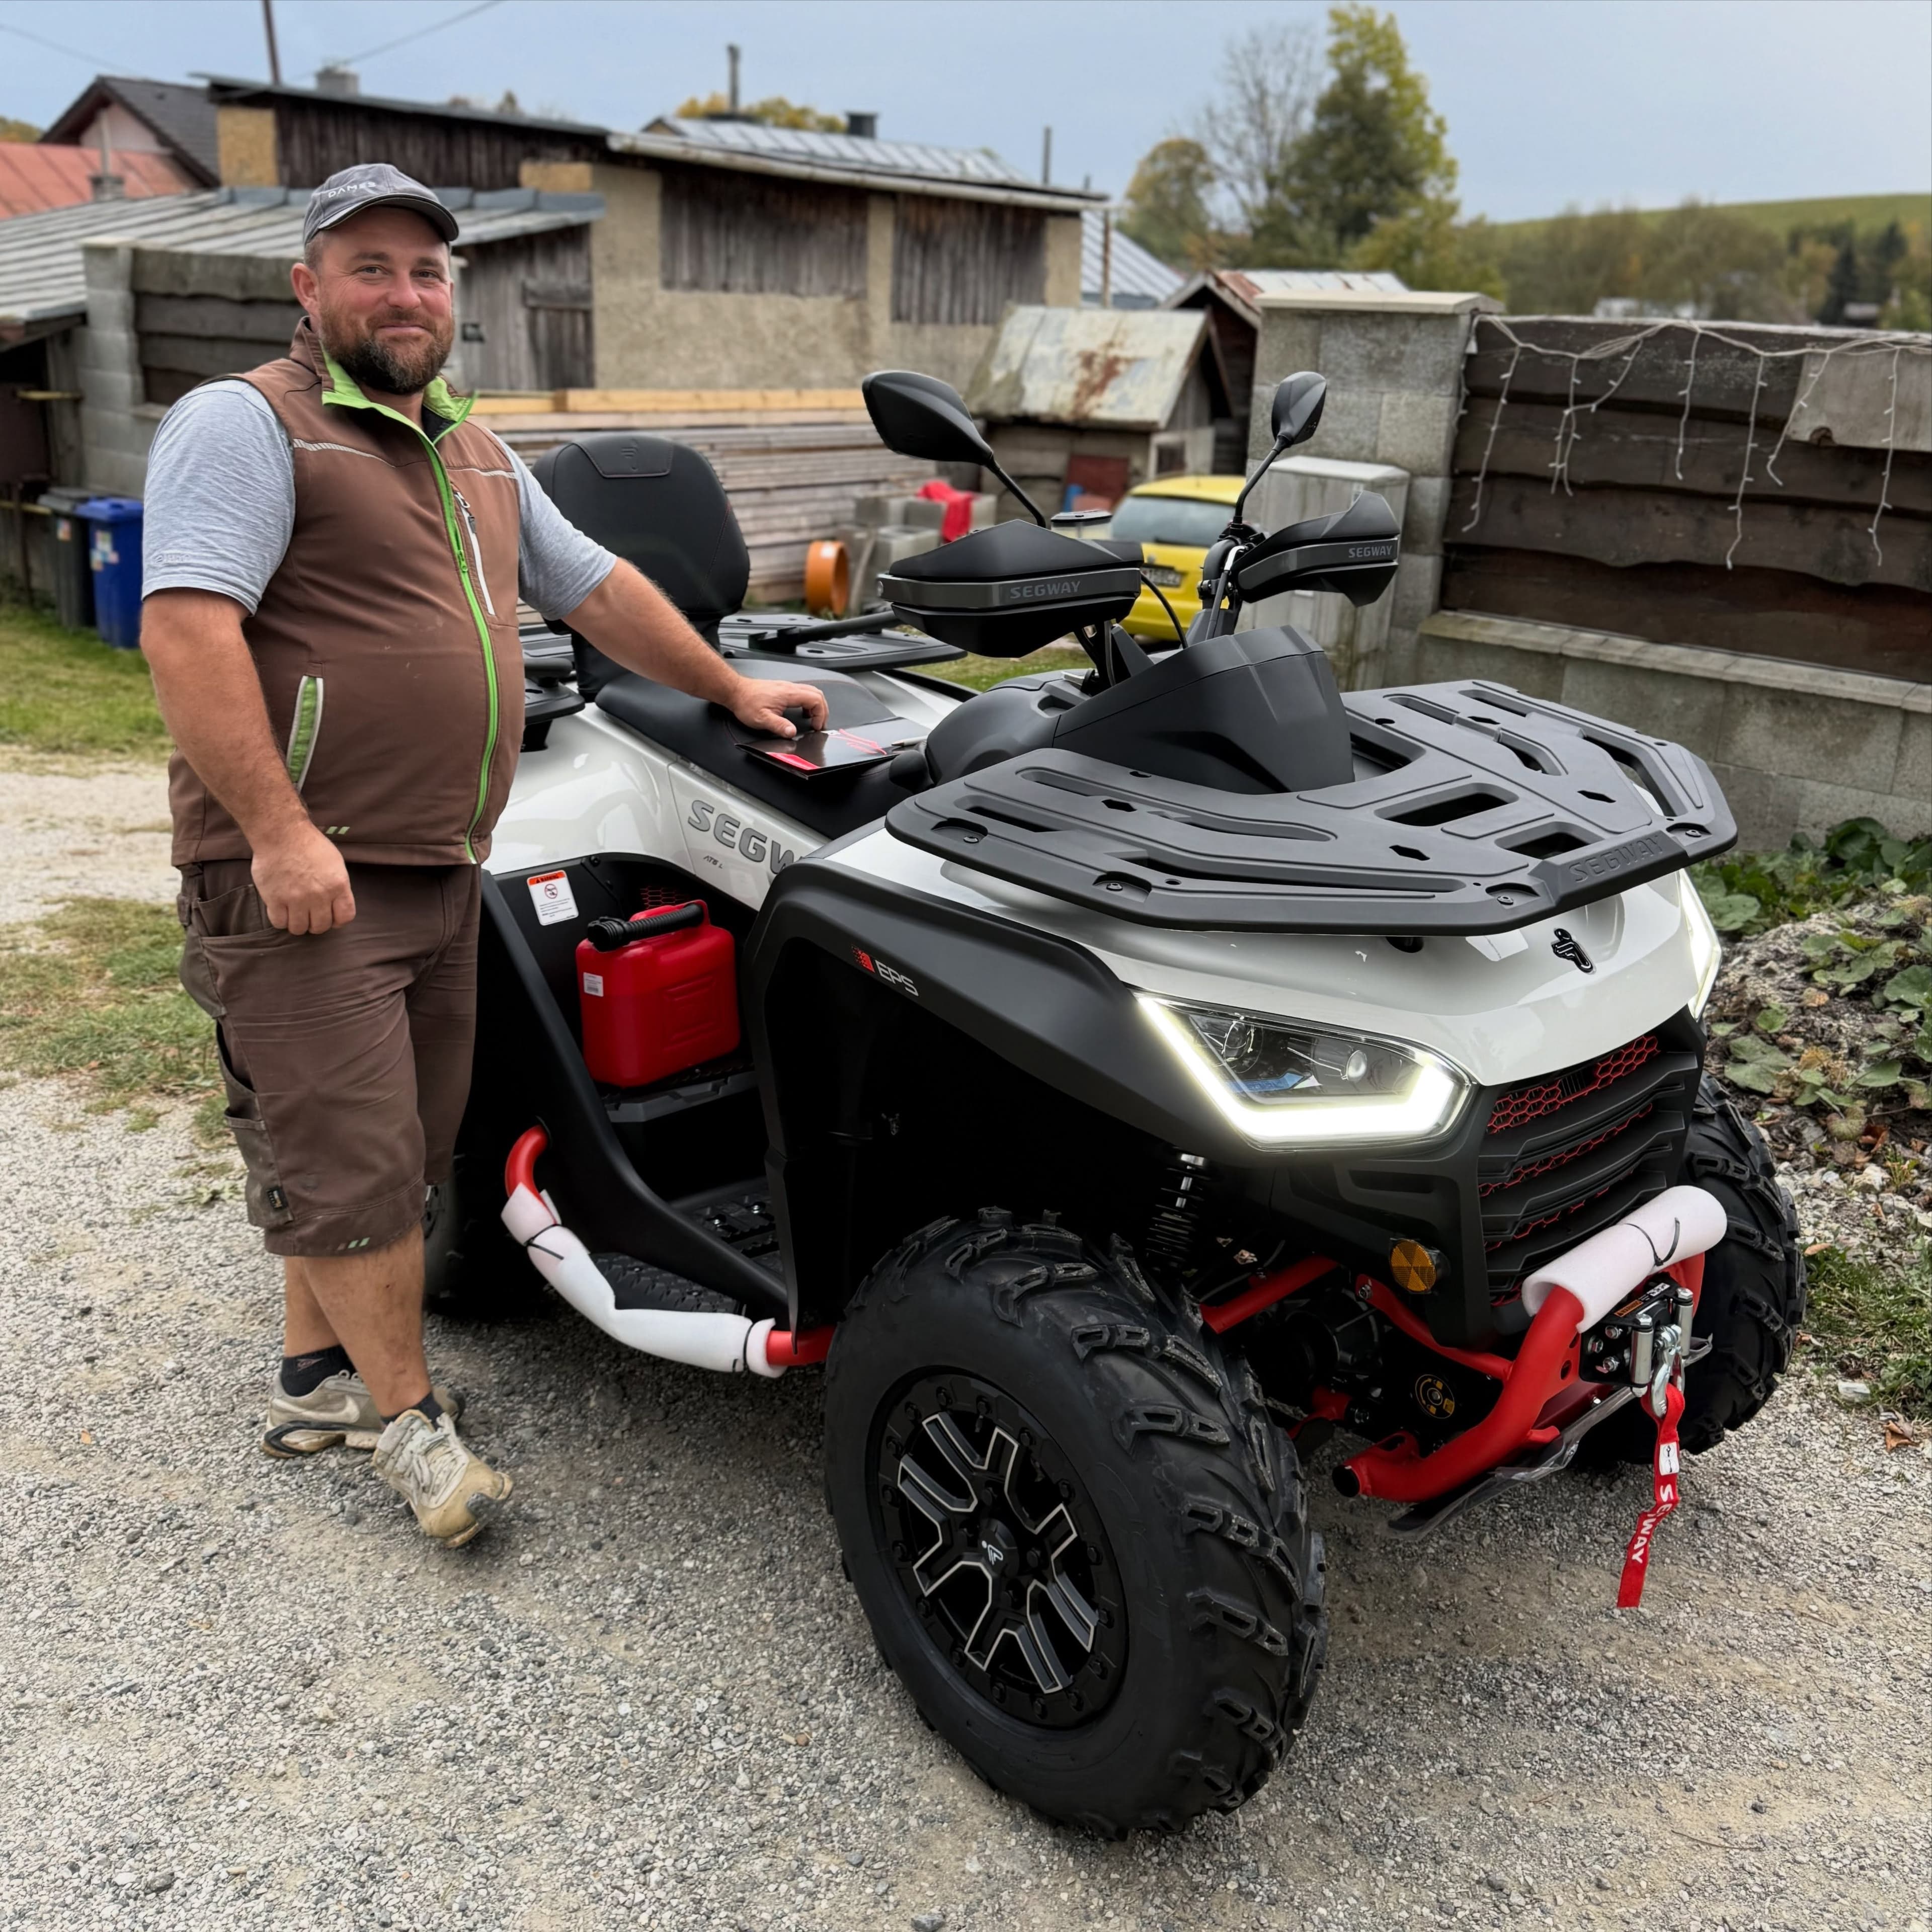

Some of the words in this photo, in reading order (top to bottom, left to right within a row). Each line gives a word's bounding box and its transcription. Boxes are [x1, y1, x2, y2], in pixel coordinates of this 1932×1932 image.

[1348, 545, 1392, 558] SEGWAY
[1010, 580, 1080, 599] SEGWAY
[688, 800, 803, 874] SEGW
[1569, 835, 1663, 882] SEGWAY
[875, 959, 919, 996] EPS
